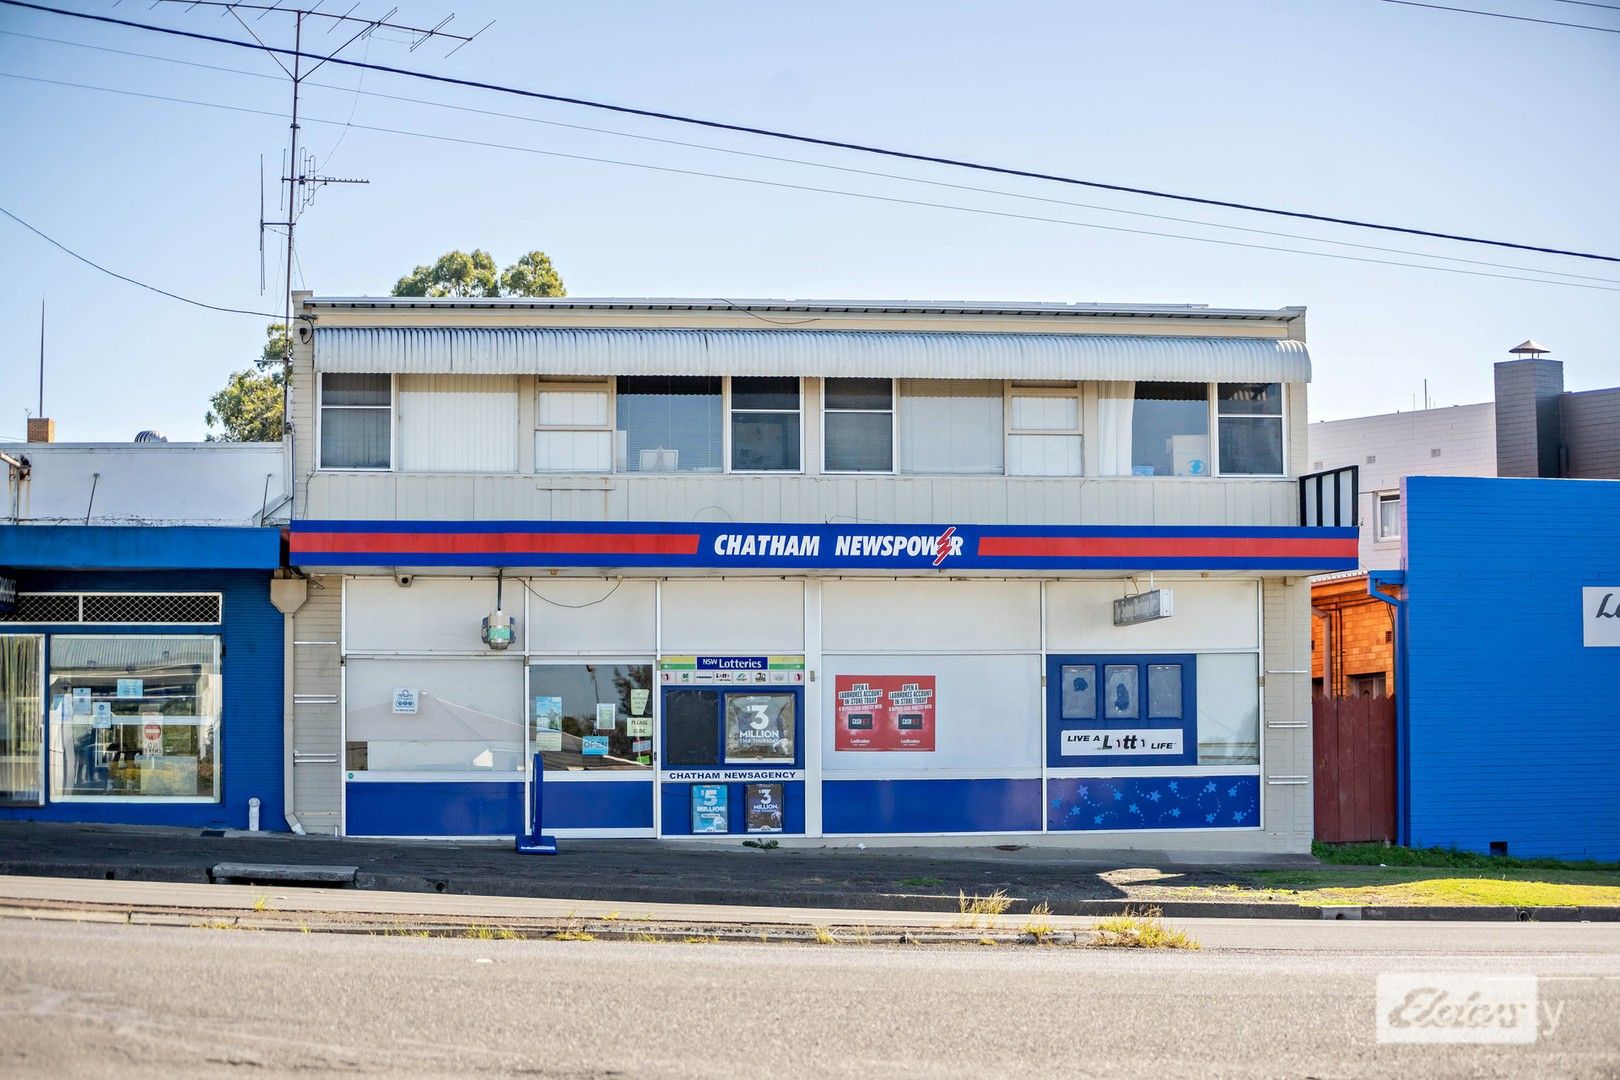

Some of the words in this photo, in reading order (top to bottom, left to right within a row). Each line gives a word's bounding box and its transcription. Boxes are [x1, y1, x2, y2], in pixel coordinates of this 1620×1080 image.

[714, 534, 820, 556] CHATHAM
[835, 527, 963, 566] NEWSPOWER
[719, 658, 762, 669] Lotteries
[746, 704, 769, 730] $3
[740, 730, 779, 738] MILLION
[724, 771, 796, 779] NEWSAGENCY
[700, 789, 718, 807] $5
